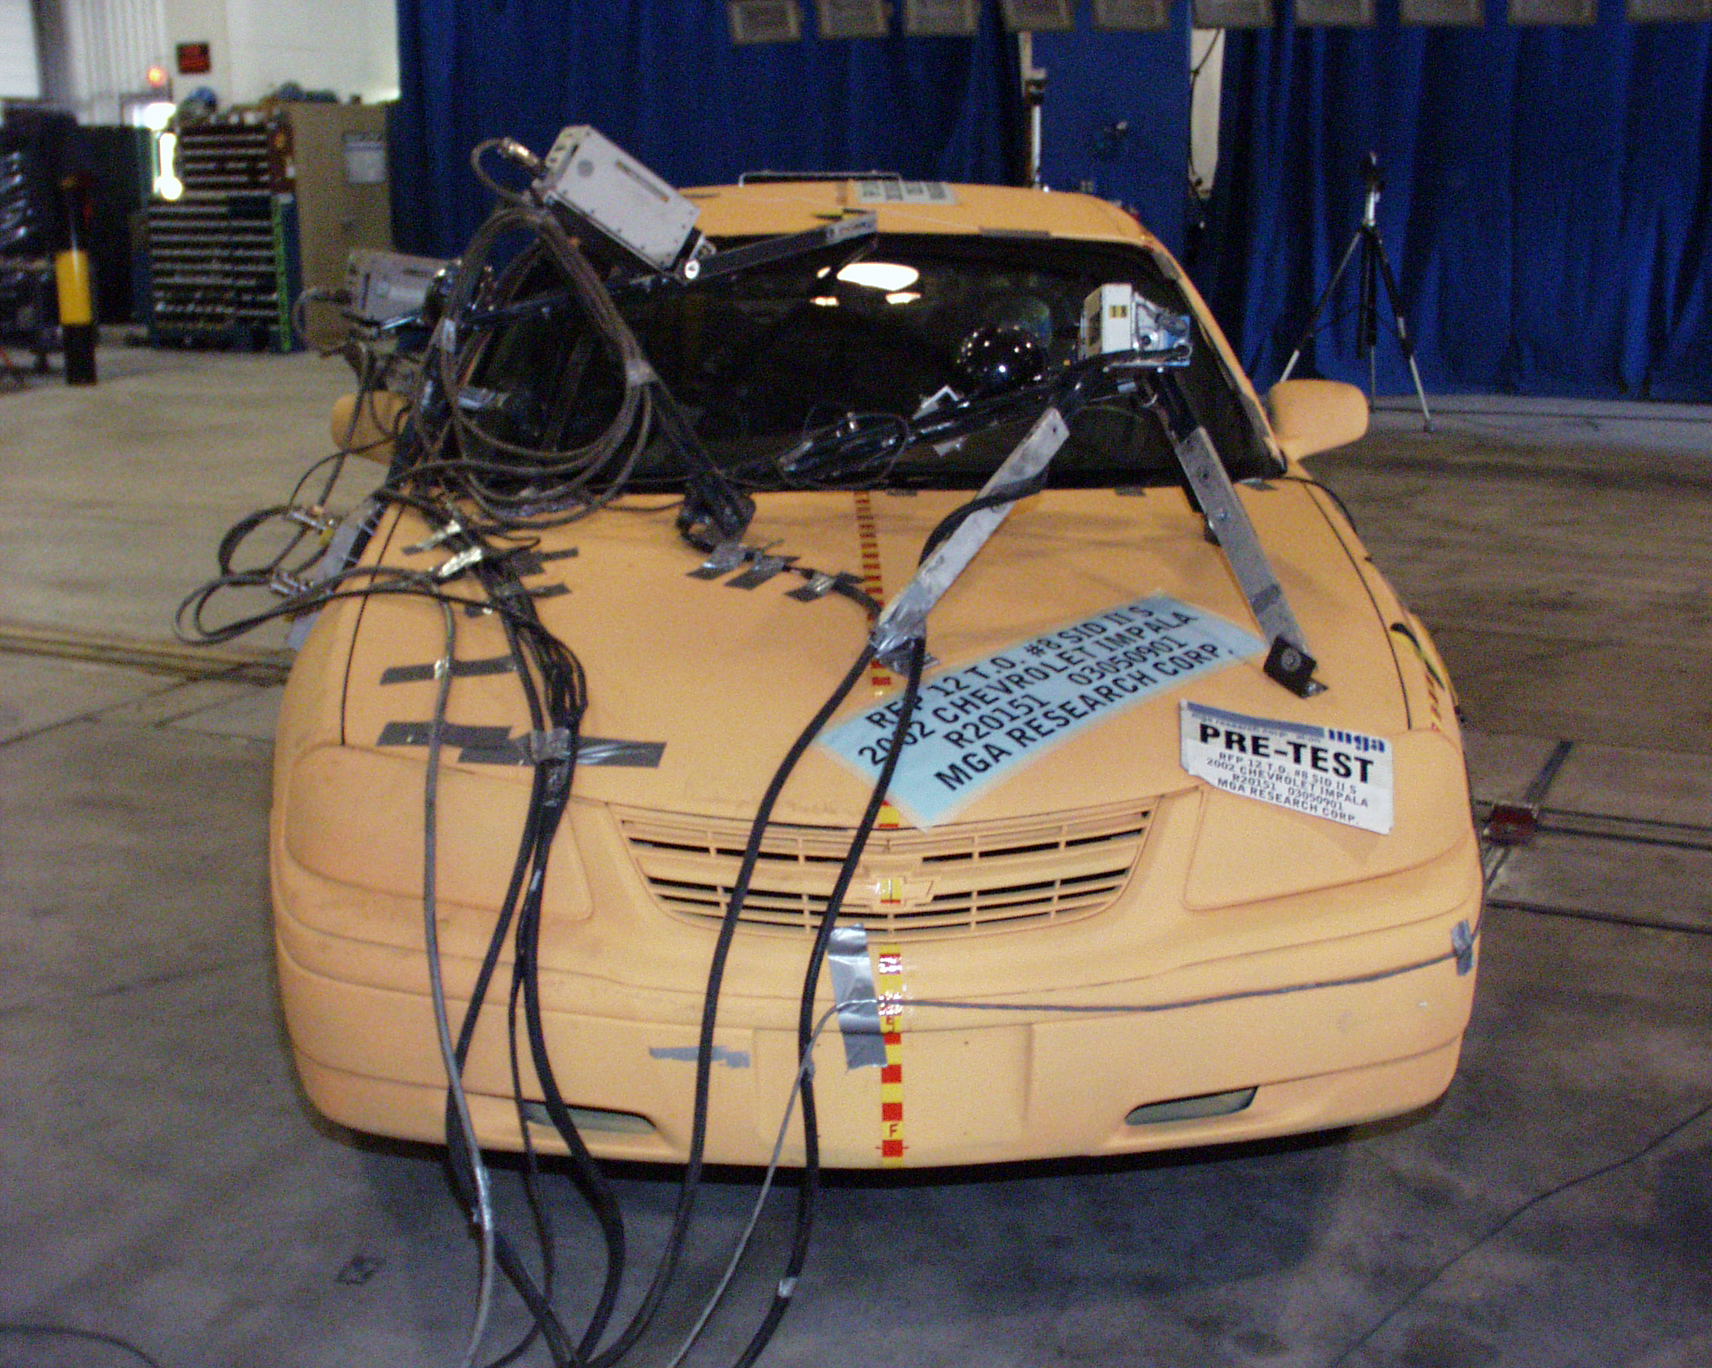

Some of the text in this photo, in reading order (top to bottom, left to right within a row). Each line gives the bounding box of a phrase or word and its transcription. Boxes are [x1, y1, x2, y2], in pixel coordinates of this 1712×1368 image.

[927, 676, 970, 697] 12
[1024, 638, 1061, 657] #8
[1057, 623, 1108, 643] SID
[1103, 611, 1135, 626] II
[1128, 605, 1154, 617] S
[858, 611, 1198, 765] 2002 CHEVROLET IMPALA
[943, 635, 1188, 749] R20151 03050901
[934, 742, 1012, 791] MGA
[1005, 669, 1158, 748] RESEARCH
[1152, 643, 1234, 676] CORP.
[1328, 729, 1385, 753] mga
[1199, 722, 1374, 784] PRE-TEST
[1219, 751, 1244, 764] RFP
[1249, 759, 1262, 769] 12
[1206, 757, 1369, 808] 2002 CHEVROLET IMPALA
[1218, 778, 1246, 793] MGA
[1250, 787, 1318, 813] RESEARCH
[1232, 773, 1275, 791] R20151
[889, 1123, 898, 1138] F
